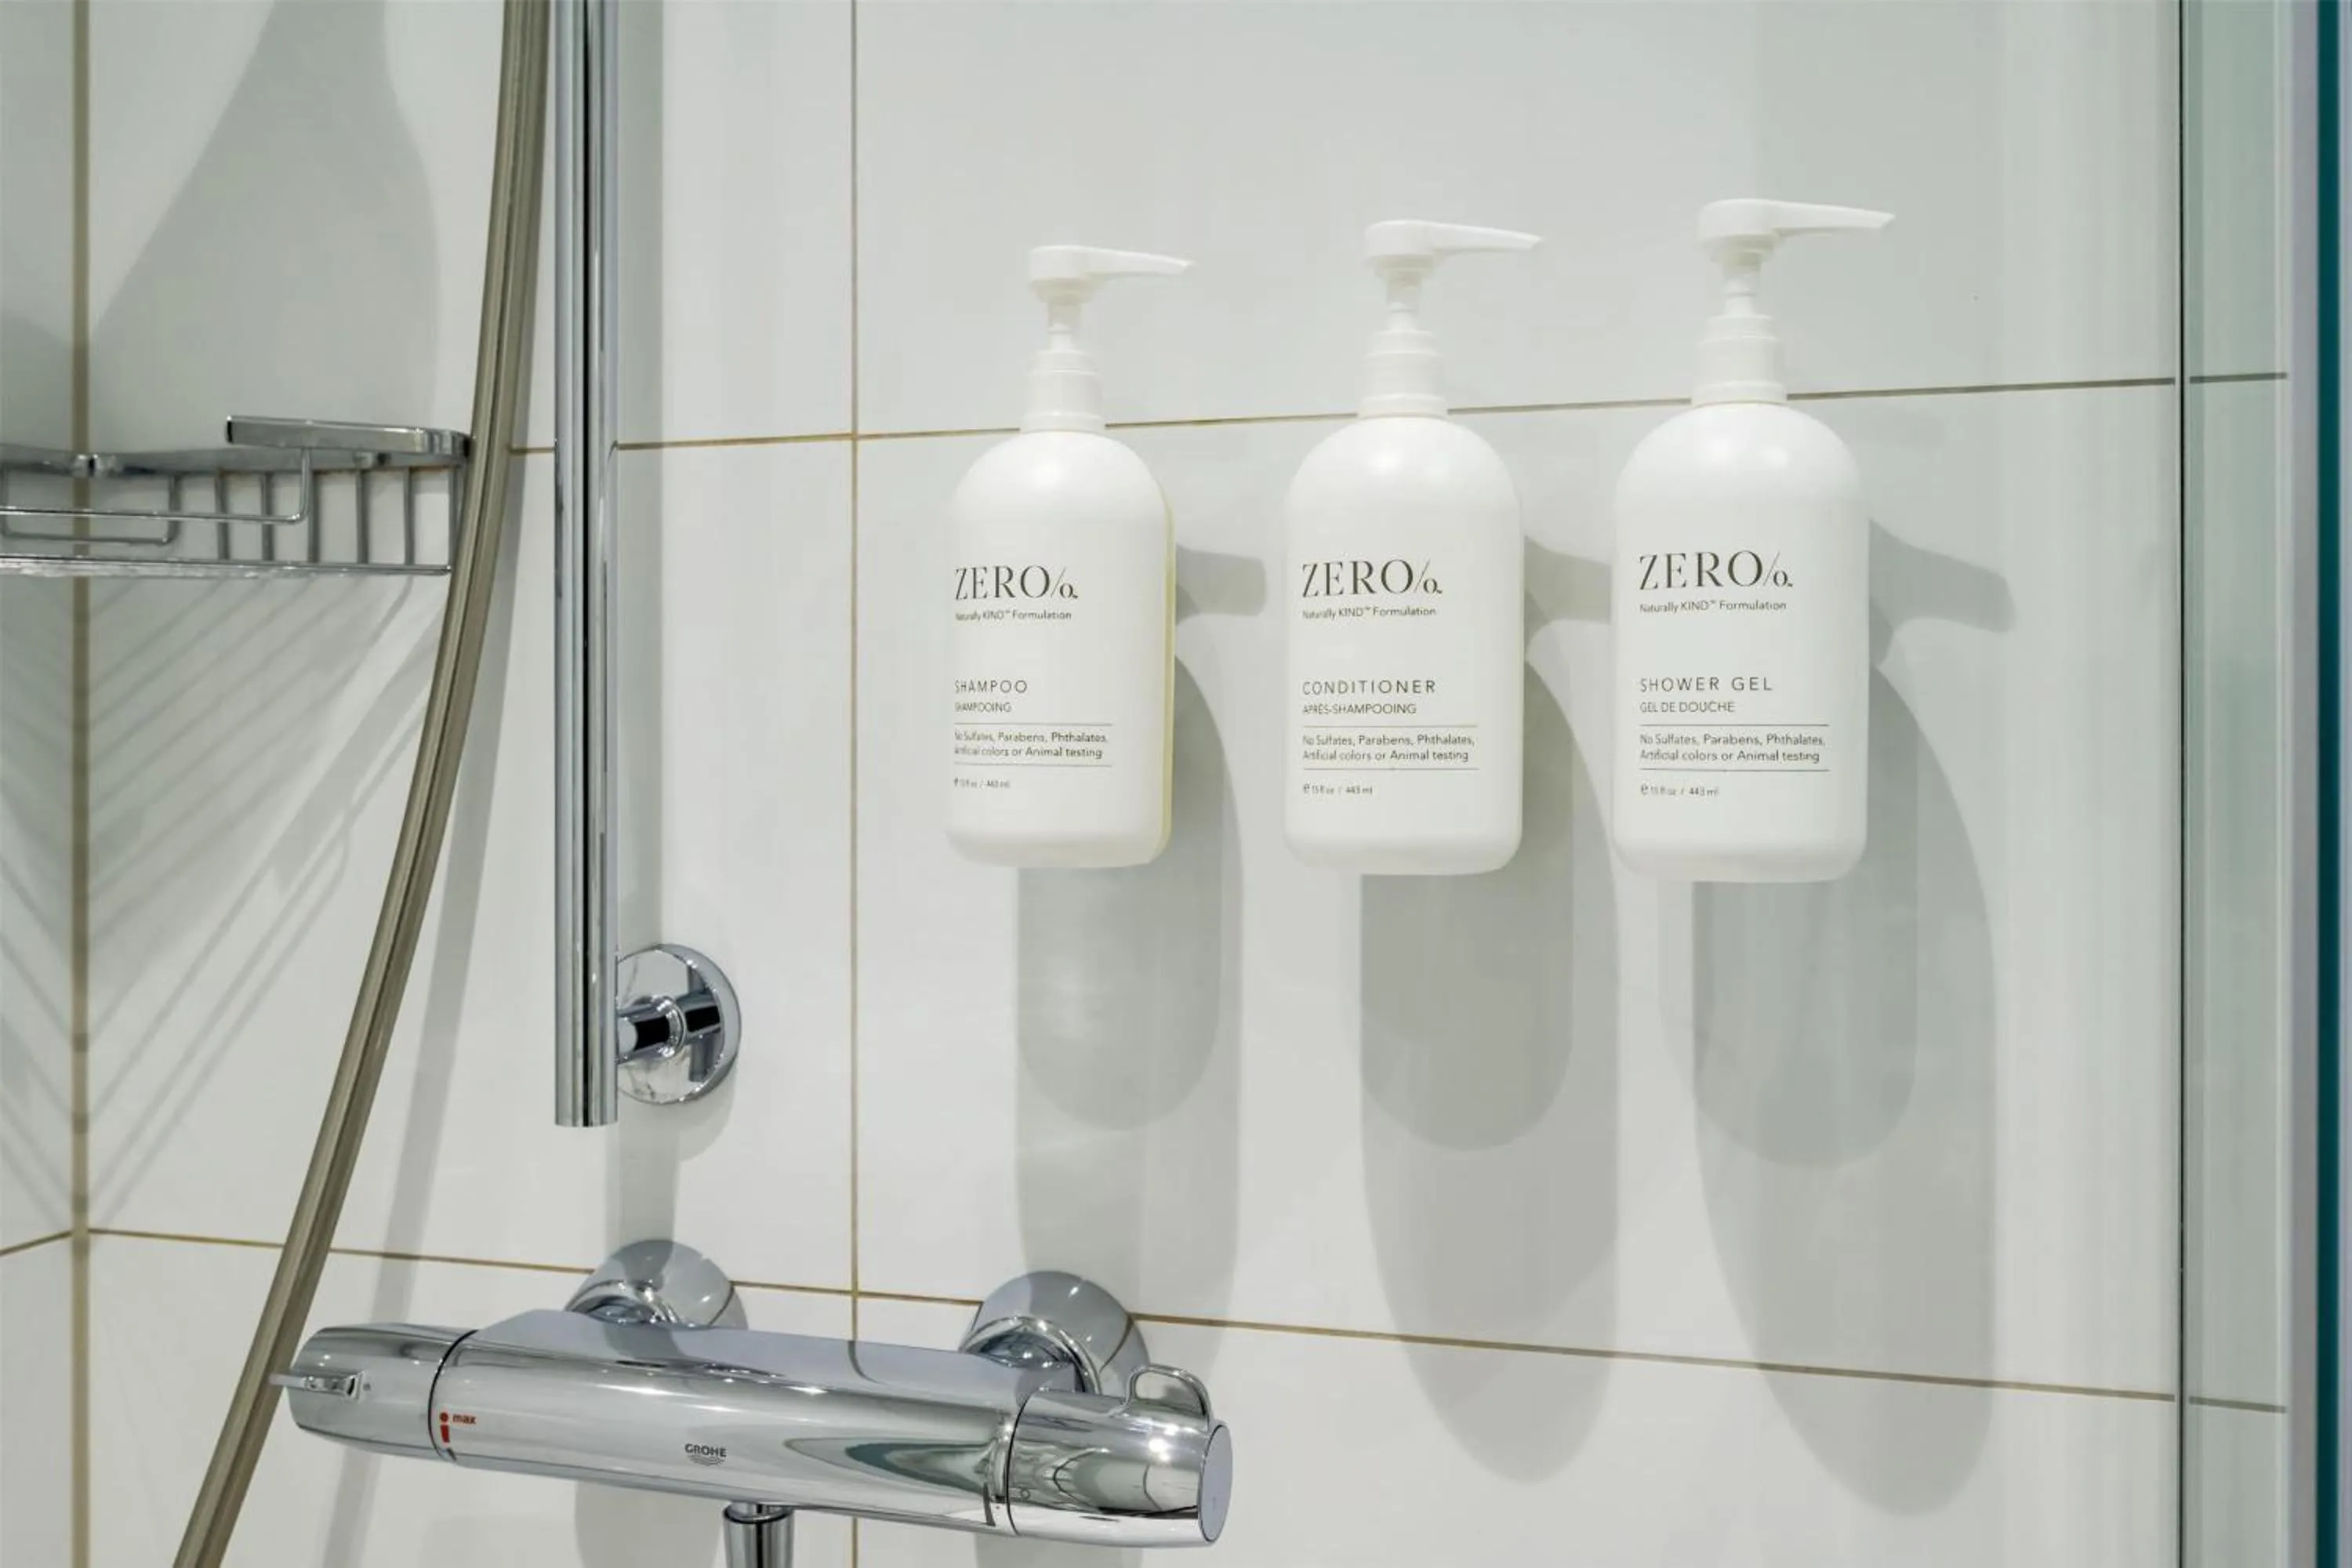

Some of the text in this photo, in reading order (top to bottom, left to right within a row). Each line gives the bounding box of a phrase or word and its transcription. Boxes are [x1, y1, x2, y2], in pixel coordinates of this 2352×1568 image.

[1372, 607, 1436, 616] Formulation
[1639, 603, 1678, 613] Naturally
[1719, 600, 1787, 610] Formulation
[1012, 610, 1071, 619] Formulation
[955, 679, 1028, 693] SHAMPOO
[1303, 680, 1436, 695] CONDITIONER
[1639, 677, 1773, 692] SHOWER GEL
[1640, 702, 1736, 713] GEL DE DOUCHE
[998, 731, 1048, 743] Parabens,
[1051, 732, 1107, 743] Phthalates,
[1302, 734, 1475, 746] No Sulfates, Parabens, Phthalates,
[1639, 734, 1825, 746] No Sulfates, Parabens, Phthalates,
[982, 746, 1009, 757] colors
[1025, 746, 1062, 757] Animal
[1065, 747, 1103, 759] testing
[1340, 750, 1371, 760] colors
[1374, 752, 1387, 760] or
[1390, 750, 1429, 760] Animal
[1432, 751, 1468, 762] testing
[1640, 750, 1820, 763] Artificial colors or Animal testing
[1688, 786, 1705, 796] 443
[452, 1414, 476, 1425] max
[684, 1443, 727, 1457] GROHE
